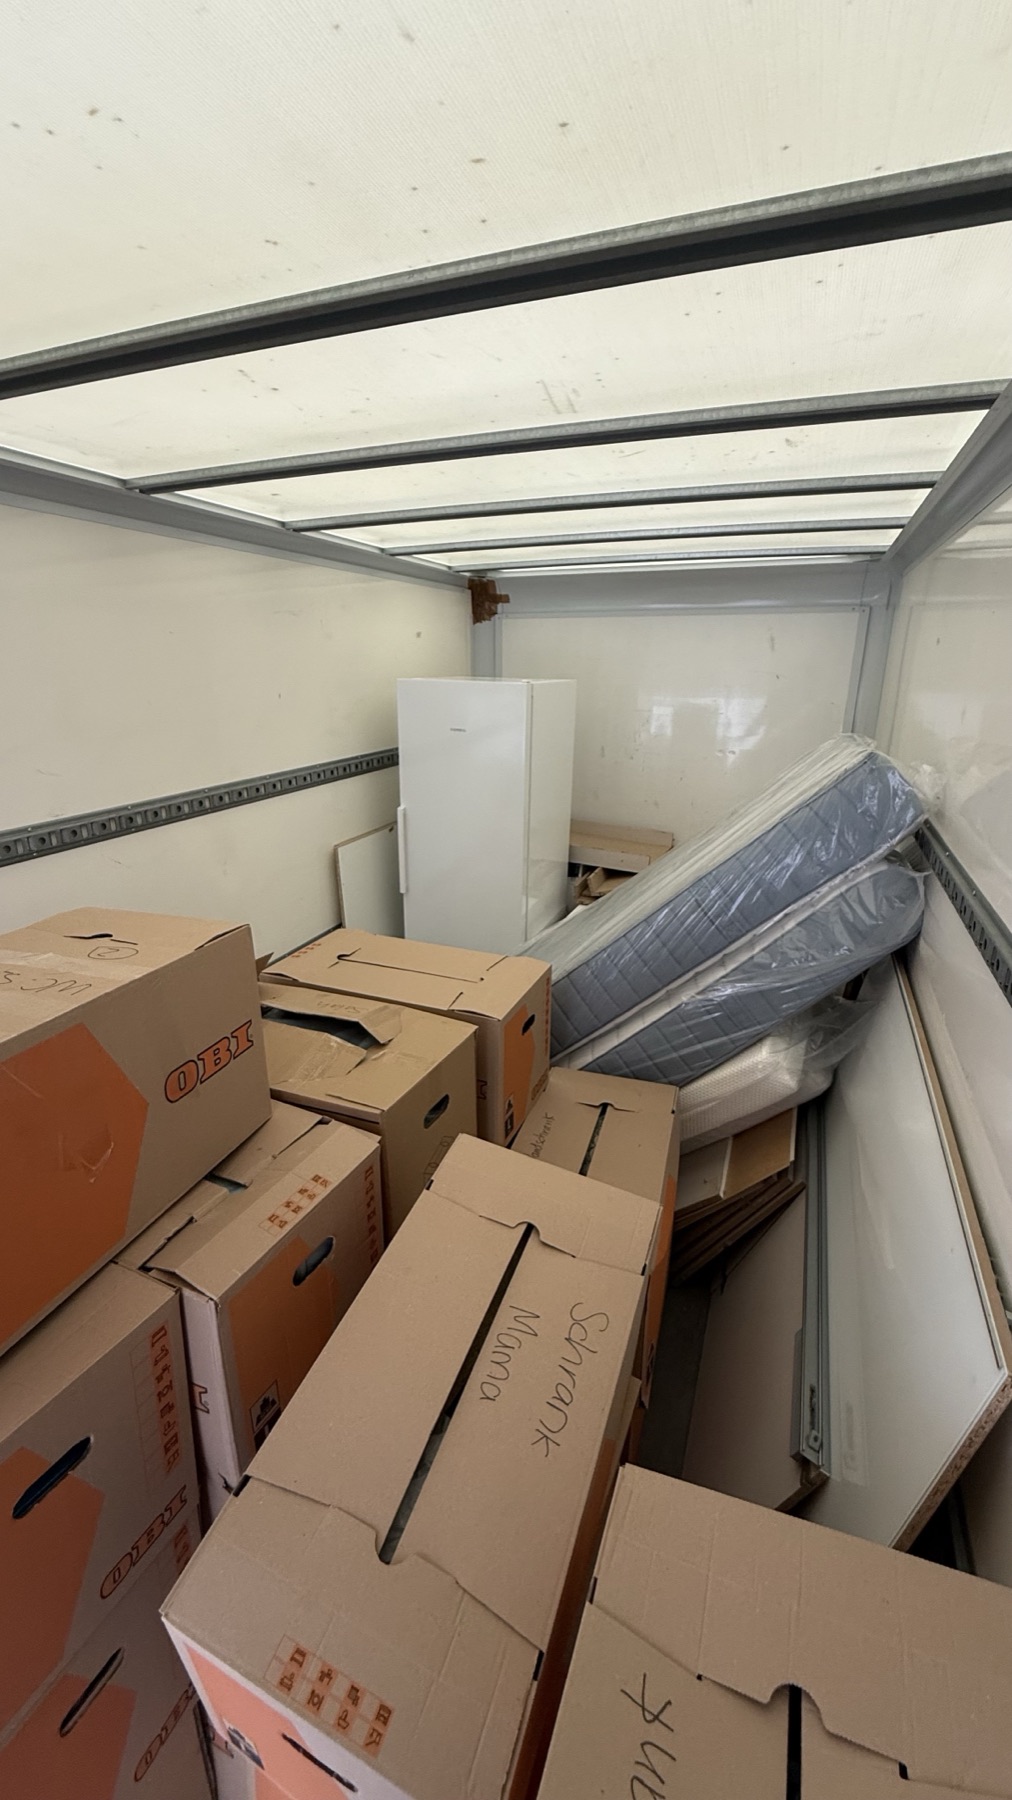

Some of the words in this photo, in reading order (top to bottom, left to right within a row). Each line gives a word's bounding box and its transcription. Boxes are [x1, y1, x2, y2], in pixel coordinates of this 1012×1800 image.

[164, 1020, 254, 1104] OBI
[479, 1305, 541, 1401] Mama
[531, 1302, 609, 1457] Schrank
[99, 1485, 188, 1600] OBI
